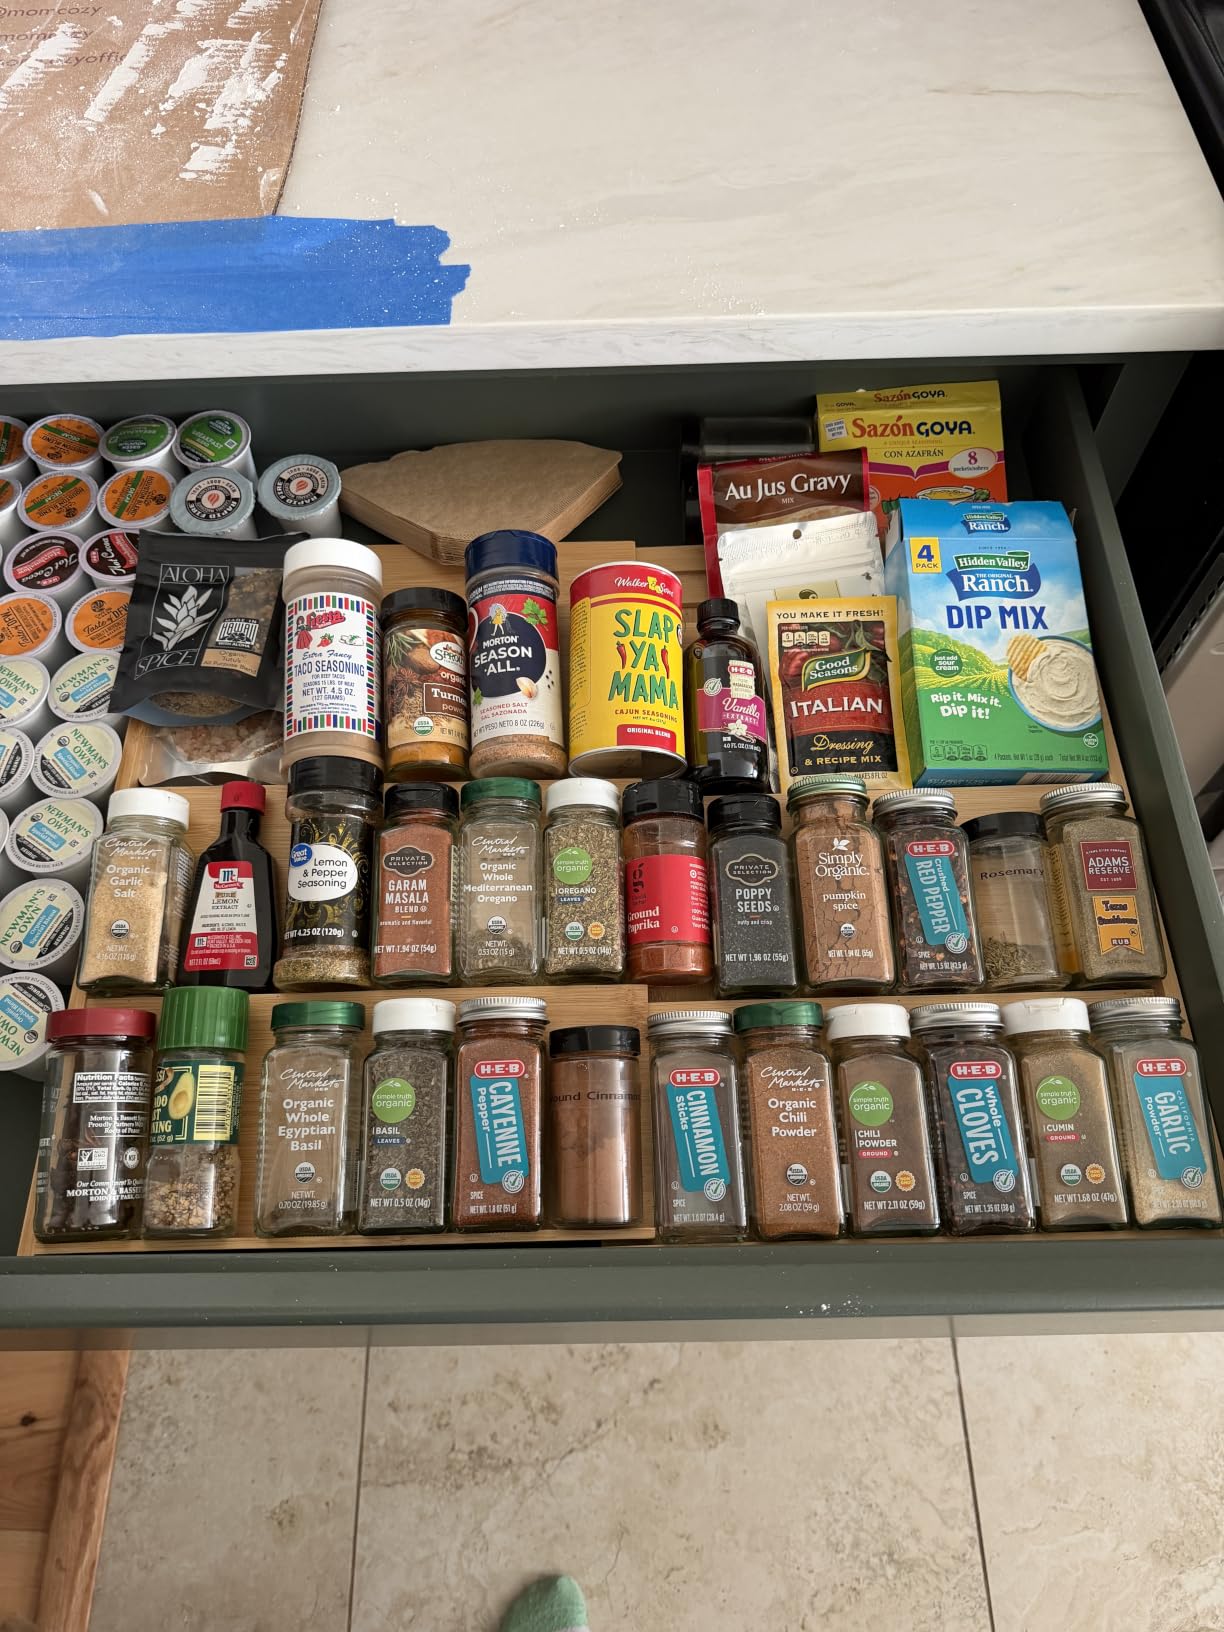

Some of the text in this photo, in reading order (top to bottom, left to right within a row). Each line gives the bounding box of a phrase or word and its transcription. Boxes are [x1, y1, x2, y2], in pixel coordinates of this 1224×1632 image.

[874, 389, 945, 403] Sazón GOYA
[852, 415, 915, 438] Sazón
[916, 421, 972, 437] GOYA
[884, 449, 944, 458] CON AZAFRÁN
[968, 451, 978, 465] 8
[725, 473, 851, 502] Au Jus Gravy
[188, 502, 207, 518] FIRE
[209, 501, 237, 519] RAPID
[969, 521, 1004, 531] Ranch
[917, 545, 934, 562] 4
[958, 556, 1027, 569] Hidden Valley
[162, 567, 227, 583] ALOHA
[615, 576, 649, 588] Walker
[961, 575, 1029, 592] Ranch
[846, 609, 884, 617] FRESH!
[946, 606, 1048, 630] DIP MIX
[219, 622, 259, 638] HAWAII
[614, 609, 674, 643] SLAP
[483, 636, 518, 649] MORTON
[302, 650, 352, 660] Extra Fancy
[474, 646, 533, 668] SEASON
[629, 640, 659, 672] YA
[137, 651, 192, 674] SPICE
[294, 660, 365, 677] TACO SEASONING
[815, 656, 850, 671] Good
[56, 657, 109, 693] NEWMAN'S
[809, 664, 858, 680] Seasons
[73, 670, 99, 688] OWN
[302, 689, 313, 697] NET
[344, 688, 356, 696] OZ.
[608, 671, 679, 710] MAMA
[931, 693, 1002, 707] Rip it. Mix it.
[480, 703, 511, 715] SEASONED
[722, 698, 760, 719] Vanilla
[790, 696, 883, 718] ITALIAN
[940, 704, 990, 720] Dip it!
[642, 709, 678, 723] SEASONING
[726, 713, 756, 725] EXTRACT
[627, 727, 670, 738] ORIGINAL BLEND
[70, 728, 109, 769] NEWMAN'S
[810, 734, 874, 755] Dressing
[73, 745, 93, 766] OWN
[816, 756, 857, 765] RECIPE
[860, 755, 882, 763] MIX
[44, 804, 91, 838] NEWMAN'S
[47, 818, 70, 835] OWN
[105, 838, 151, 848] Central
[472, 831, 519, 846] Central
[109, 847, 162, 857] Market
[478, 845, 529, 855] Market
[314, 858, 348, 867] Lemon
[818, 852, 864, 867] Simply
[1088, 856, 1129, 867] ADAMS
[106, 864, 150, 875] Organic
[480, 862, 516, 871] Organic
[557, 865, 589, 873] organic
[815, 865, 867, 880] Organic
[1088, 866, 1131, 875] RESERVE
[311, 868, 347, 879] Pepper
[483, 872, 513, 881] Whole
[934, 859, 949, 892] Crushed
[980, 867, 1045, 881] Rosemary
[110, 877, 143, 886] Garlic
[298, 879, 347, 890] Seasoning
[388, 880, 427, 891] GARAM
[114, 889, 137, 898] Salt
[463, 884, 533, 893] Mediterranean
[736, 888, 772, 899] POPPY
[385, 892, 429, 904] MASALA
[477, 895, 517, 904] Oregano
[823, 891, 866, 902] pumpkin
[915, 860, 951, 934] RED PEPPER
[395, 905, 418, 913] BLEND
[628, 906, 660, 920] Ground
[737, 901, 771, 913] SEEDS
[832, 902, 858, 912] spice
[0, 888, 45, 945] NEWMAN'S
[18, 906, 42, 933] OWN
[628, 919, 660, 935] Paprika
[280, 1068, 331, 1080] Central
[760, 1066, 810, 1078] Central
[287, 1078, 345, 1090] Market
[768, 1077, 824, 1089] Market
[282, 1098, 334, 1111] Organic
[375, 1099, 412, 1109] organic
[767, 1098, 817, 1109] Organic
[853, 1102, 890, 1112] organic
[984, 1085, 1001, 1128] Whole
[1041, 1097, 1077, 1106] organic
[477, 1087, 490, 1132] Pepper
[675, 1095, 688, 1131] Sticks
[286, 1112, 329, 1122] Whole
[778, 1112, 807, 1123] Chili
[1144, 1097, 1161, 1137] Powder
[1154, 1091, 1191, 1155] GARLIC
[1177, 1090, 1195, 1143] CALIFORNIA
[375, 1127, 400, 1135] BASIL
[488, 1081, 522, 1168] CAYENNE
[956, 1088, 999, 1165] CLOVES
[1046, 1123, 1074, 1132] CUMIN
[278, 1125, 336, 1139] Egyptian
[686, 1090, 720, 1176] CINNAMON
[771, 1126, 817, 1137] Powder
[858, 1130, 880, 1138] CHILI
[290, 1140, 321, 1151] Basil
[859, 1139, 897, 1148] POWDER
[66, 1188, 109, 1197] MORTON
[1054, 1192, 1117, 1203] NET WT 1.68 OZ (47g)
